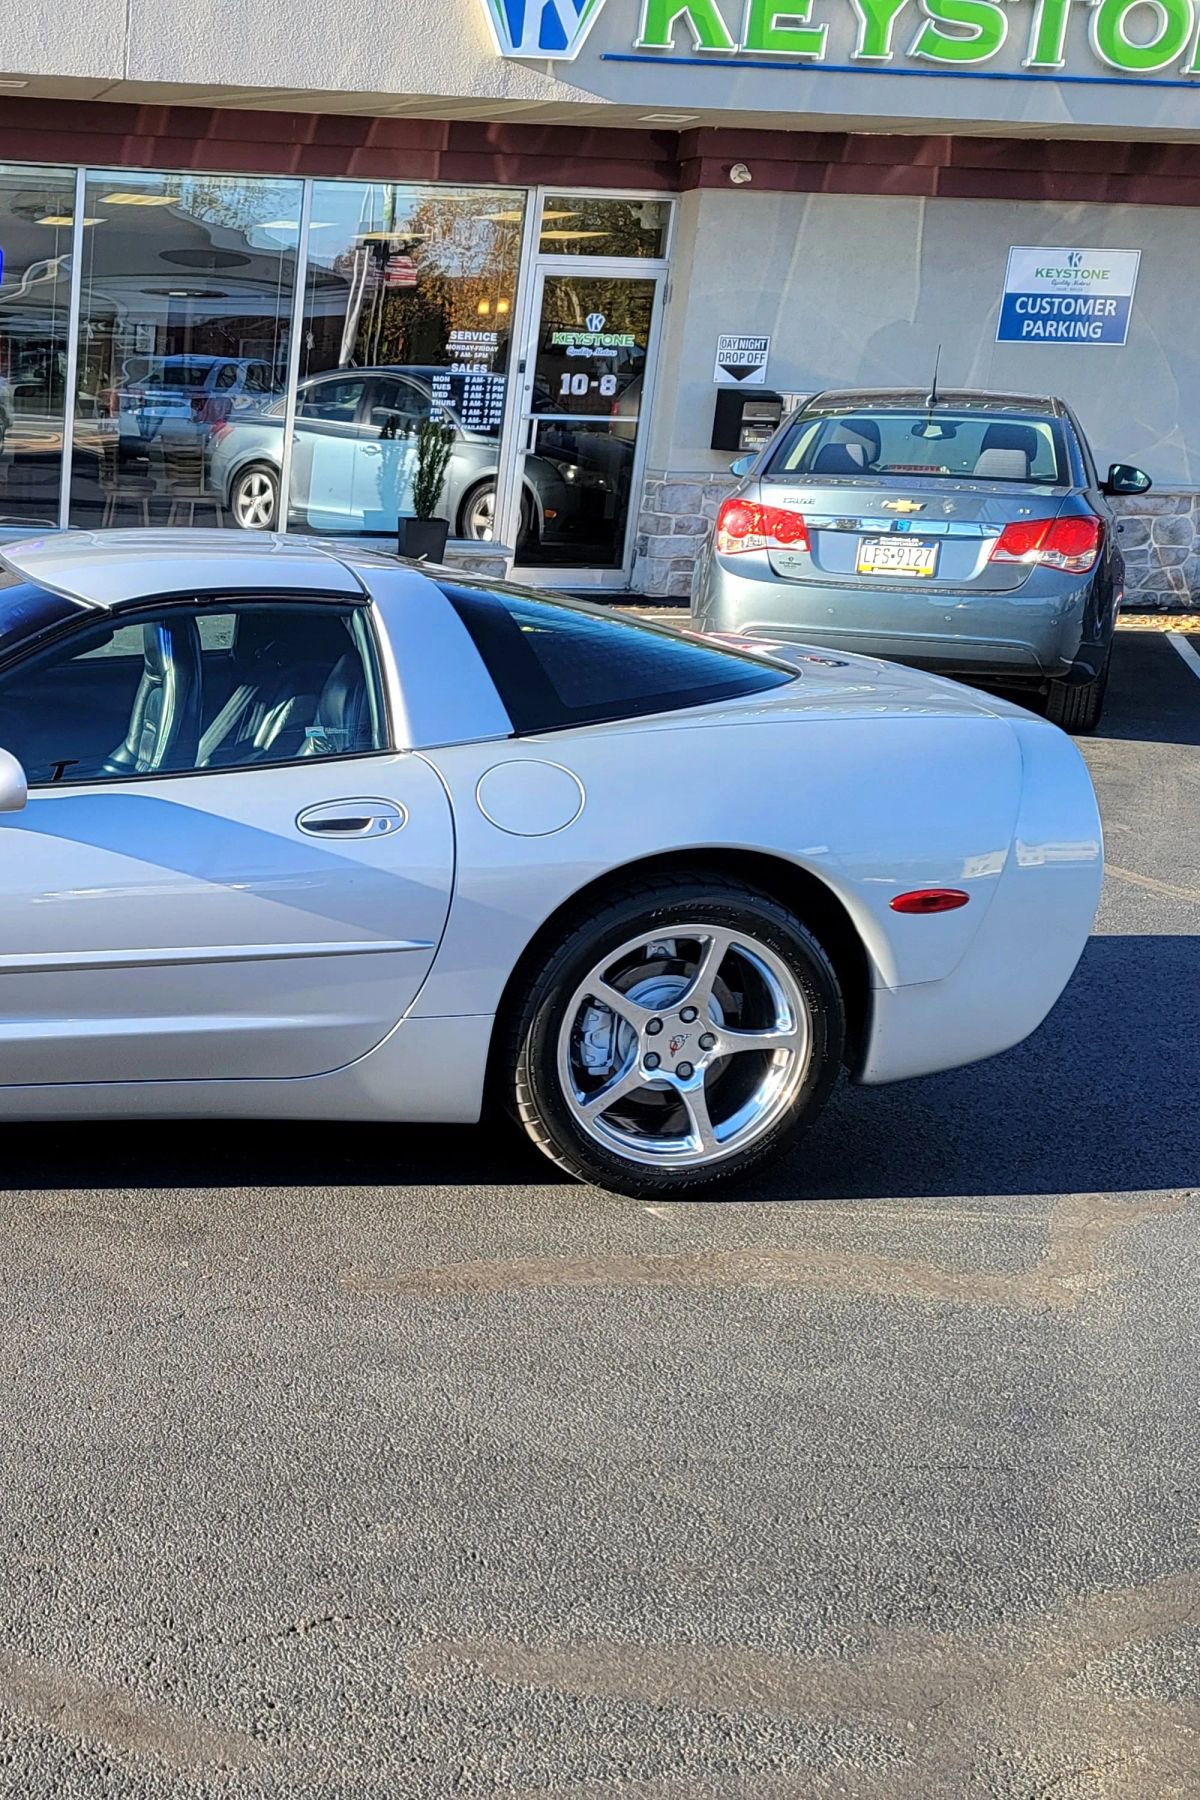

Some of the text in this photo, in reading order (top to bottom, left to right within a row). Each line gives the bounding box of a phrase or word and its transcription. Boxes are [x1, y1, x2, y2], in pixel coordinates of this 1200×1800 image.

[632, 0, 1200, 74] KEYSTO
[1035, 267, 1111, 280] KEYSTONE
[1015, 297, 1117, 316] CUSTOMER
[1022, 320, 1103, 338] PARKING
[449, 330, 498, 341] SERVICE
[552, 332, 635, 347] KEYSTONE
[445, 343, 499, 352] MONDAY-FRIDAY
[721, 339, 767, 350] DAY NIGHT
[566, 346, 593, 358] Quality
[718, 352, 766, 364] DROP OFF
[450, 363, 488, 373] SALES
[432, 383, 451, 391] TUES
[560, 373, 617, 396] 10-8
[431, 399, 456, 407] THURS
